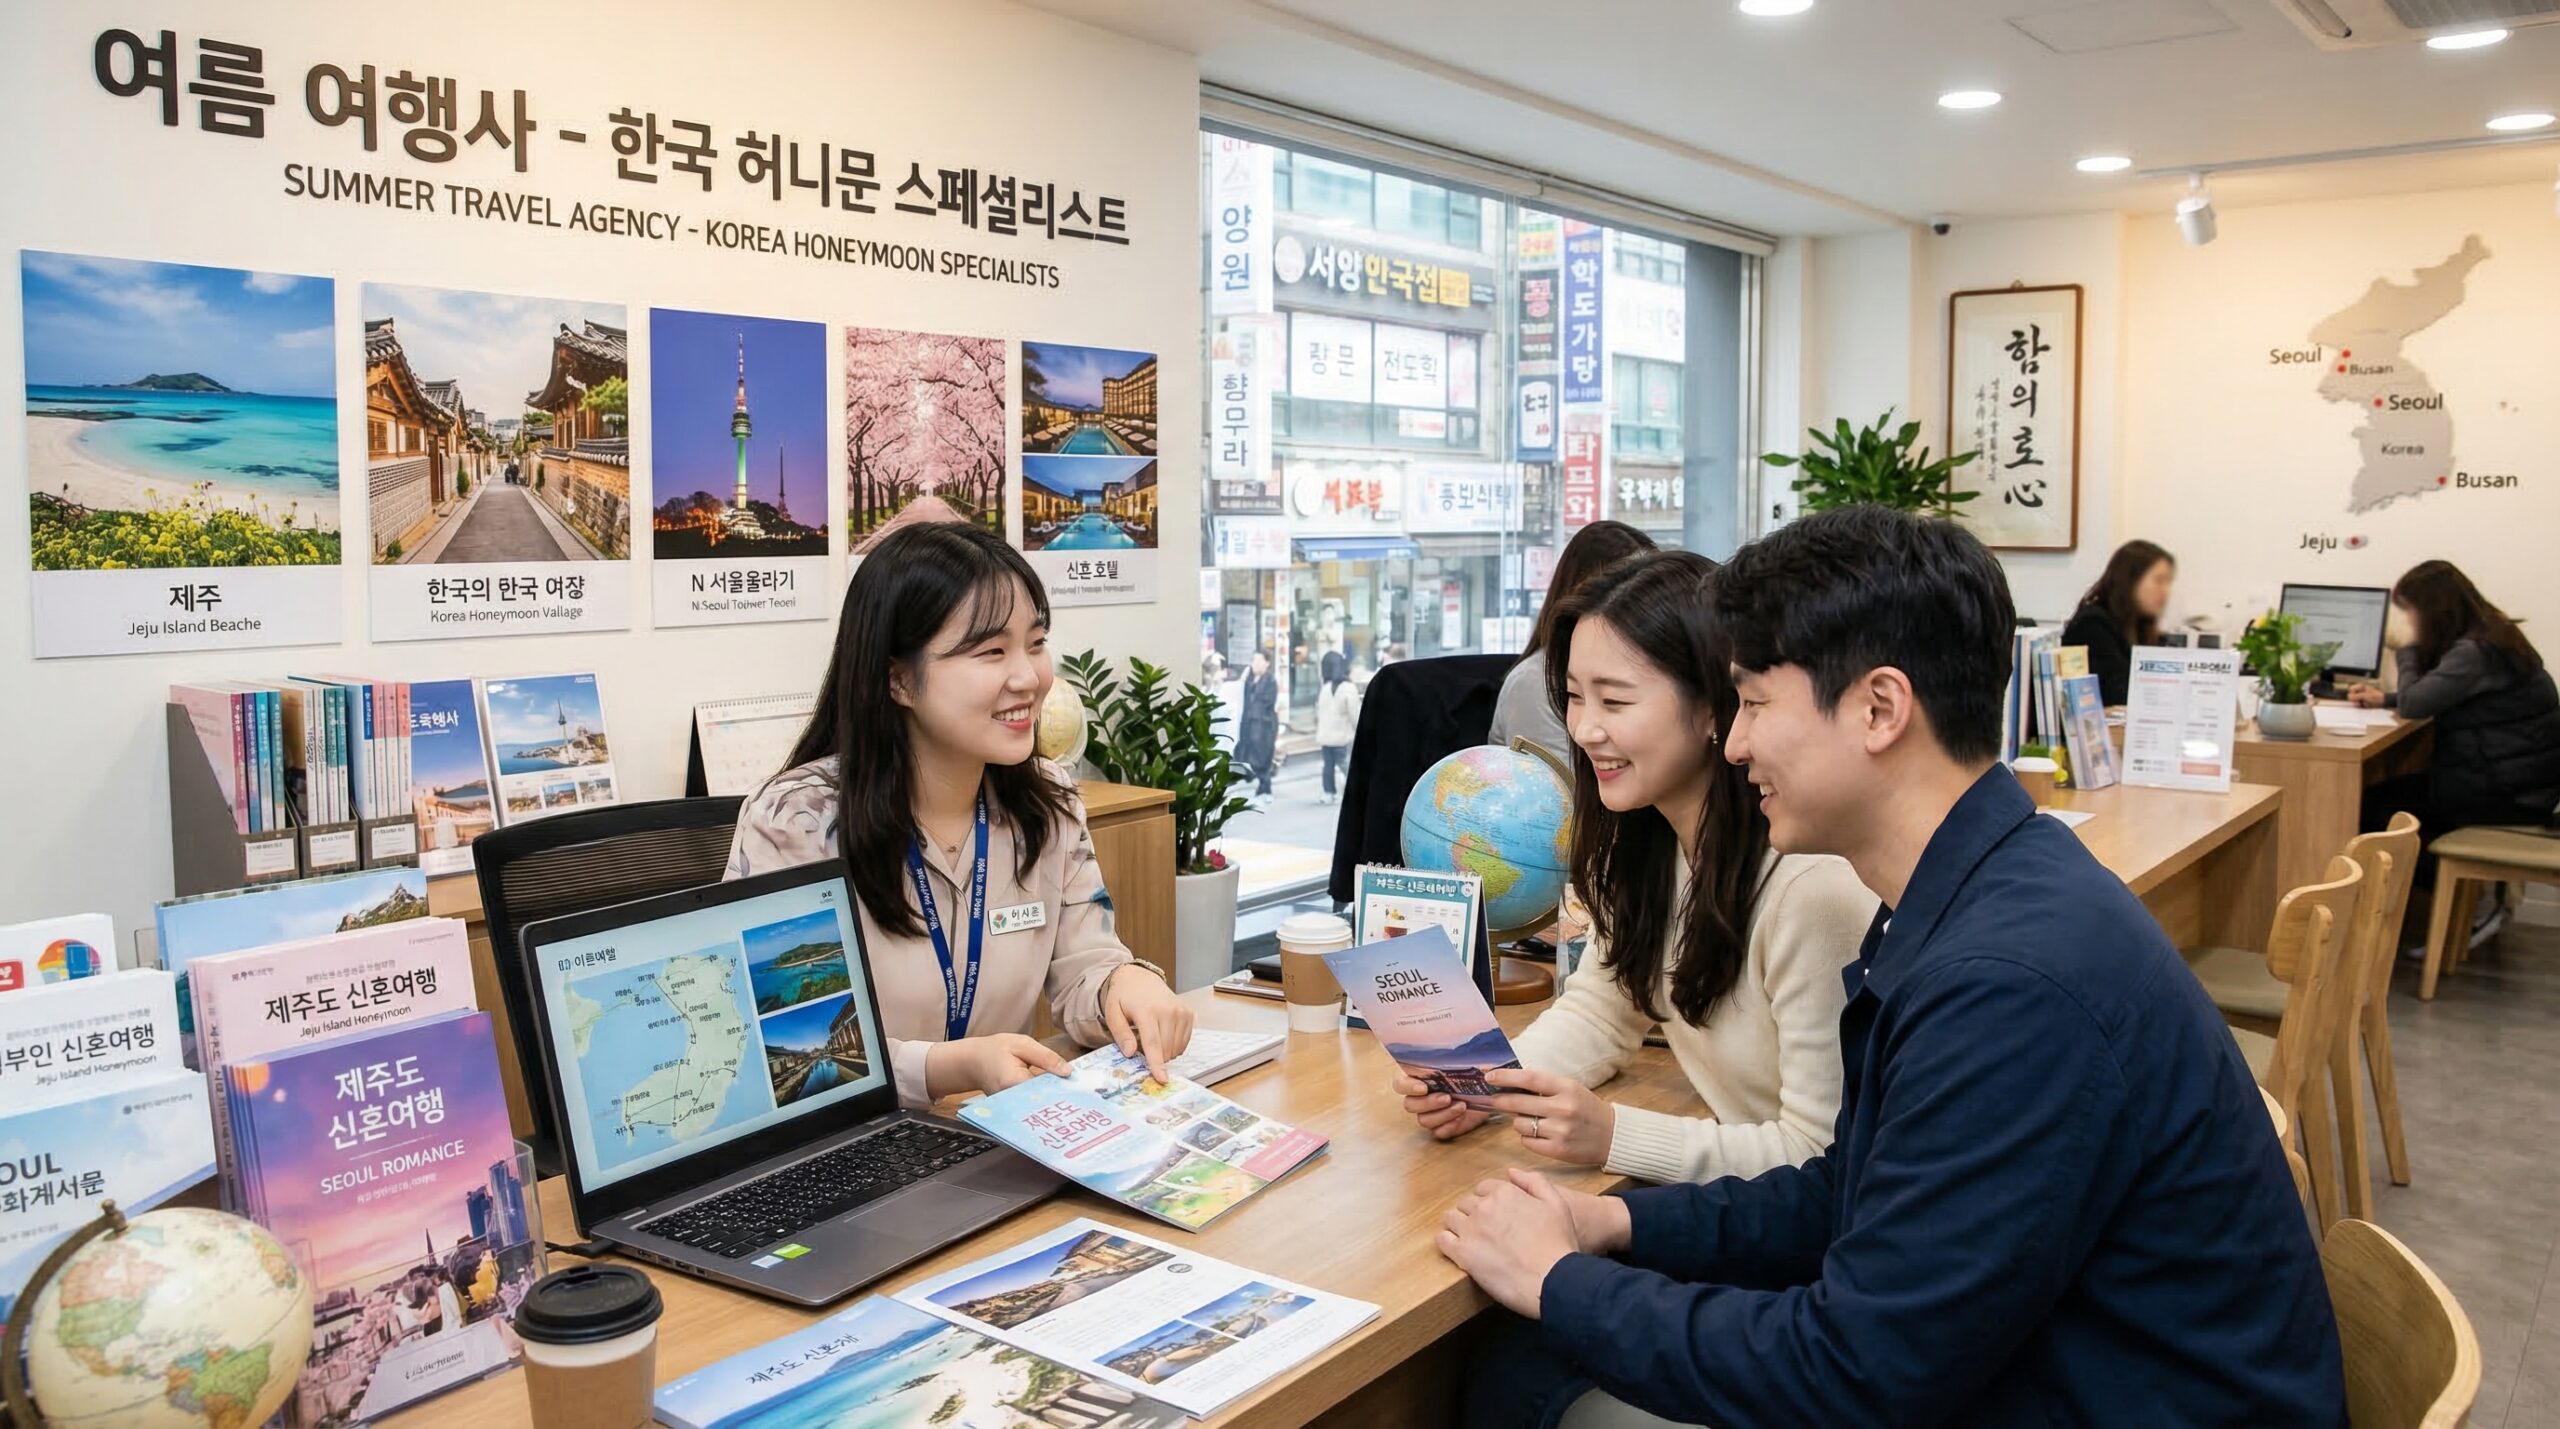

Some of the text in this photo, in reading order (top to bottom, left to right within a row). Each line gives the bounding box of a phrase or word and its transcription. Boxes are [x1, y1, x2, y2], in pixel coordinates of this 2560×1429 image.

[94, 28, 1131, 246] 여름 여행사 - 한국 허니문 스페셜리스트
[283, 162, 436, 213] SUMMER
[443, 183, 562, 229] TRAVEL
[568, 202, 681, 242] AGENCY
[705, 219, 788, 256] KOREA
[793, 233, 936, 275] HONEYMOON
[940, 250, 1060, 290] SPECIALISTS
[2269, 346, 2323, 365] Seoul
[2349, 363, 2394, 376] Busan
[2388, 392, 2443, 411] Seoul
[2380, 443, 2425, 456] Korea
[2455, 471, 2519, 489] Busan
[2299, 533, 2338, 554] Jeju
[426, 576, 491, 604] 한국의
[691, 573, 704, 592] N
[169, 583, 223, 612] 제주
[430, 609, 466, 623] Korea
[468, 606, 541, 624] Honeymoon
[127, 616, 262, 639] Jeju Island Beache
[1374, 967, 1429, 990] SEOUL
[265, 986, 341, 1026] 제주도
[346, 965, 438, 1010] 신혼여행
[1376, 981, 1443, 1005] ROMANCE
[299, 1023, 321, 1038] Jeju
[322, 1016, 353, 1033] Island
[61, 1022, 156, 1063] 신혼여행
[333, 1055, 426, 1103] 제주도
[327, 1086, 446, 1151] 신혼여행
[1021, 1099, 1083, 1132] 제주도
[320, 1164, 379, 1195] SEOUL
[382, 1138, 466, 1178] ROMANCE
